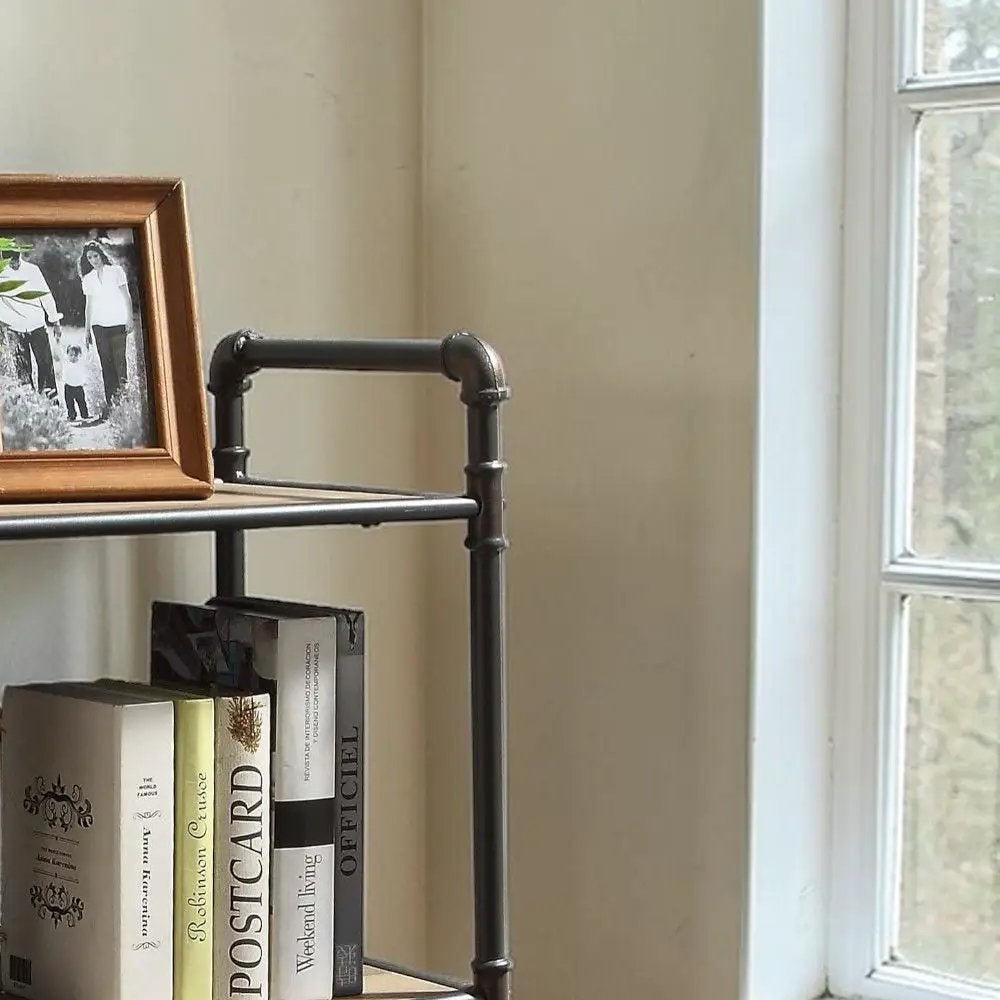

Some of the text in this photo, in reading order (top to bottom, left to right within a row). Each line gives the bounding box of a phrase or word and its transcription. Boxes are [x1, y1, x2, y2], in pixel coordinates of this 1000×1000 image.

[188, 771, 208, 943] Robinson Crusoe
[339, 725, 359, 877] OFFICIEL
[142, 826, 152, 937] Anna Karenina
[229, 764, 263, 998] POSTCARD
[296, 855, 322, 976] Weekend living
